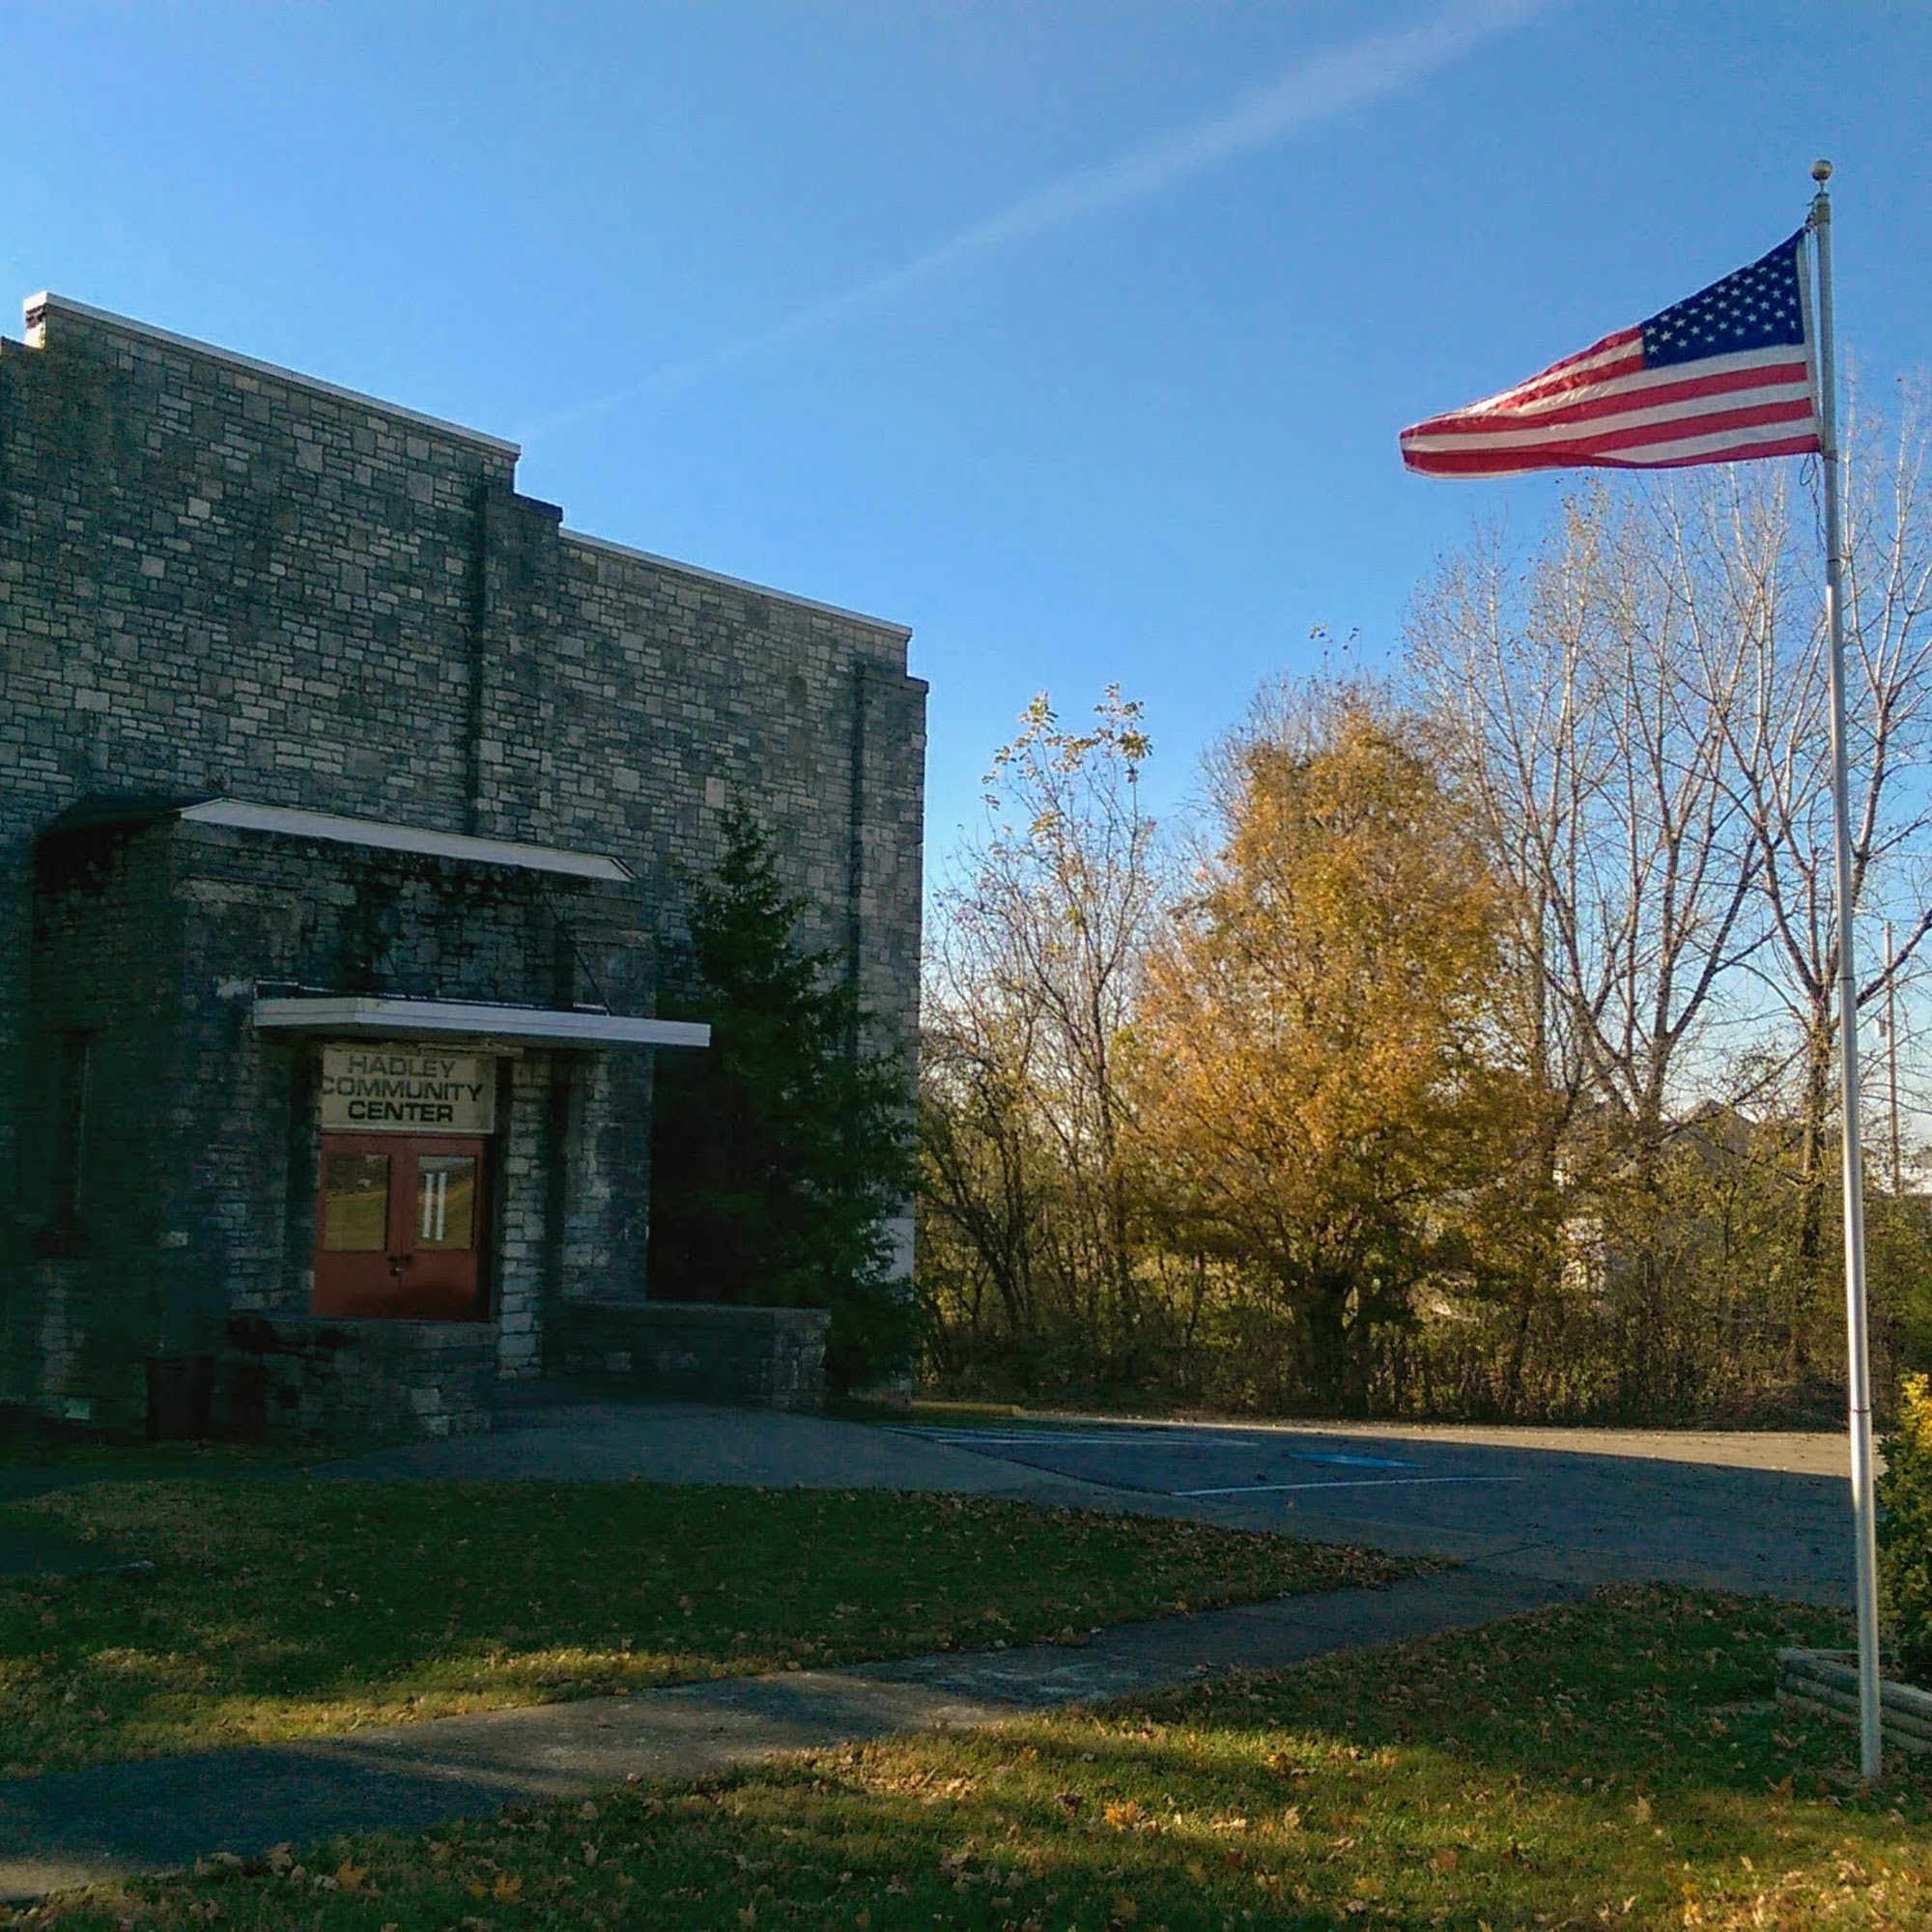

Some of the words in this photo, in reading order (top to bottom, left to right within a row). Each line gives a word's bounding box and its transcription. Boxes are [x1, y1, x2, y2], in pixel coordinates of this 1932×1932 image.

[349, 1055, 457, 1078] HADLEY
[321, 1077, 483, 1101] COMMUNITY
[348, 1100, 454, 1122] CENTER
